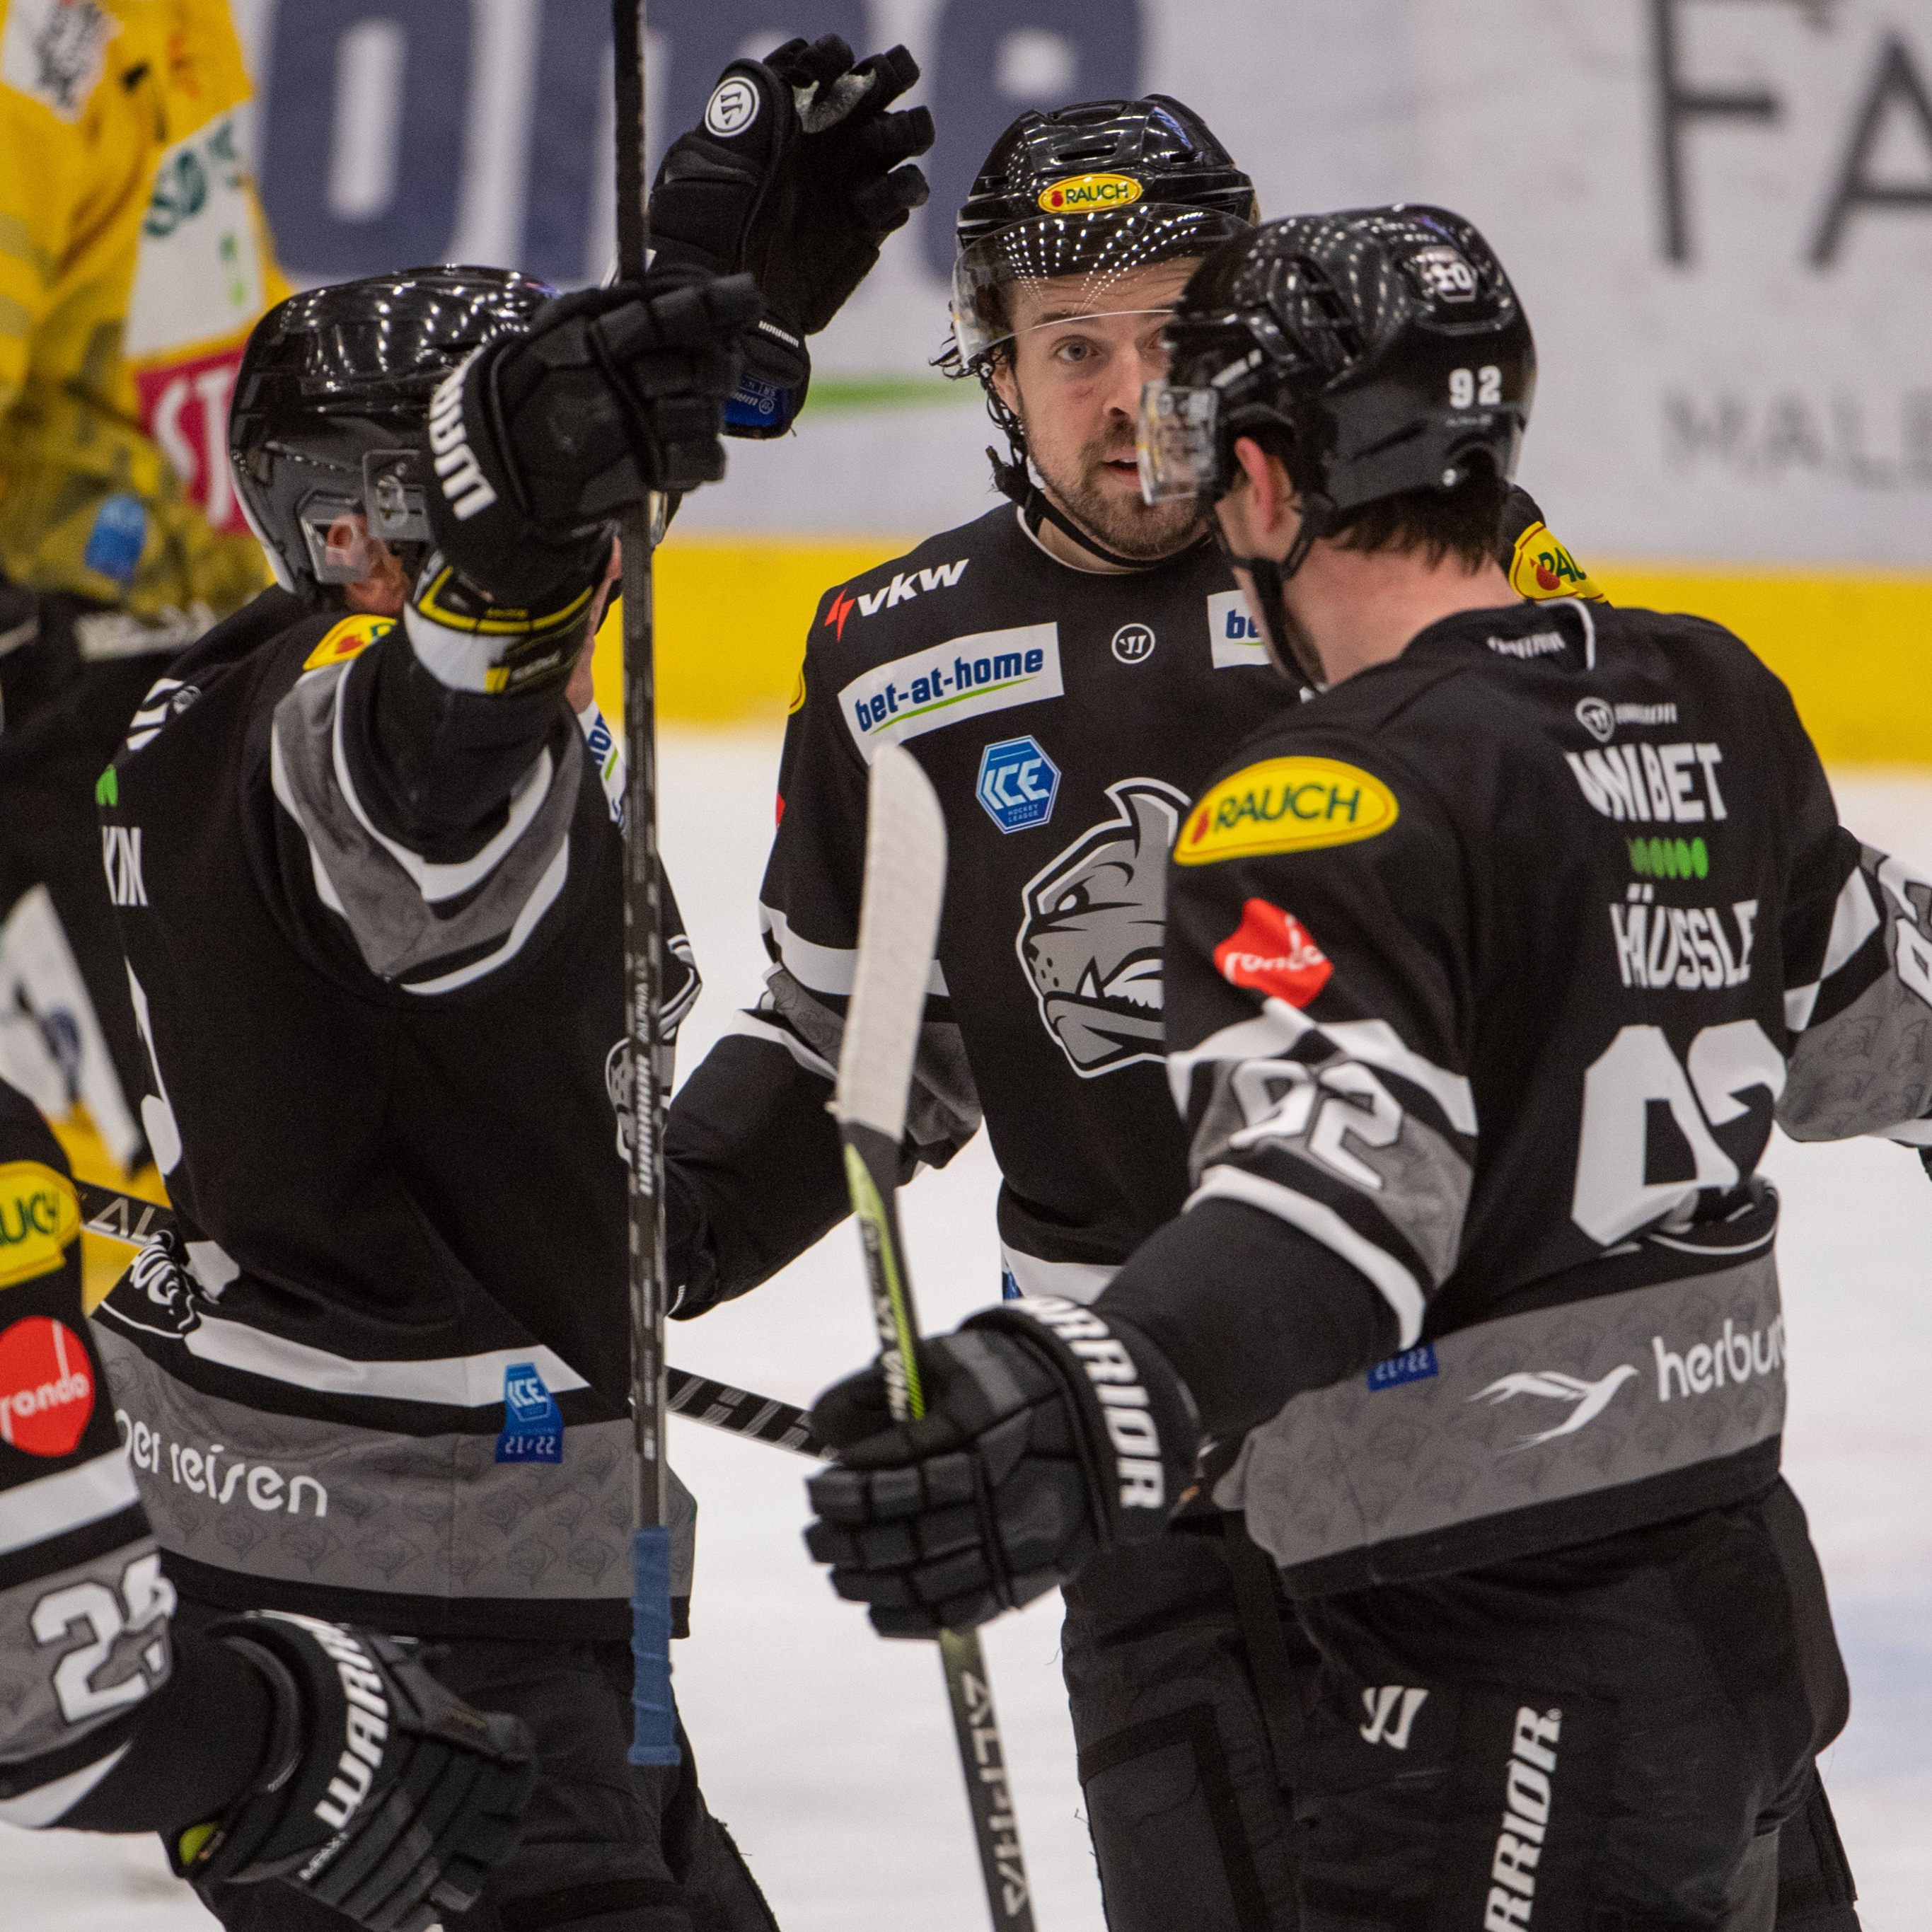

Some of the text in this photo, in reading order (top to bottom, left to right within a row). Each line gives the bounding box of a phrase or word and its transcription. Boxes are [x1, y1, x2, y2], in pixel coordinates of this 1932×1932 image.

[1065, 182, 1129, 204] RAUCH
[1448, 365, 1503, 410] 92
[857, 557, 970, 618] vkw
[854, 647, 1044, 733] bet-at-home
[982, 757, 1051, 811] ICE
[1214, 782, 1361, 833] RAUCH
[1007, 803, 1039, 817] HOCKEY
[1007, 811, 1040, 823] LEAGUE
[1229, 1060, 1403, 1191] 92
[507, 1377, 547, 1408] ICE
[170, 1441, 328, 1517] reisen
